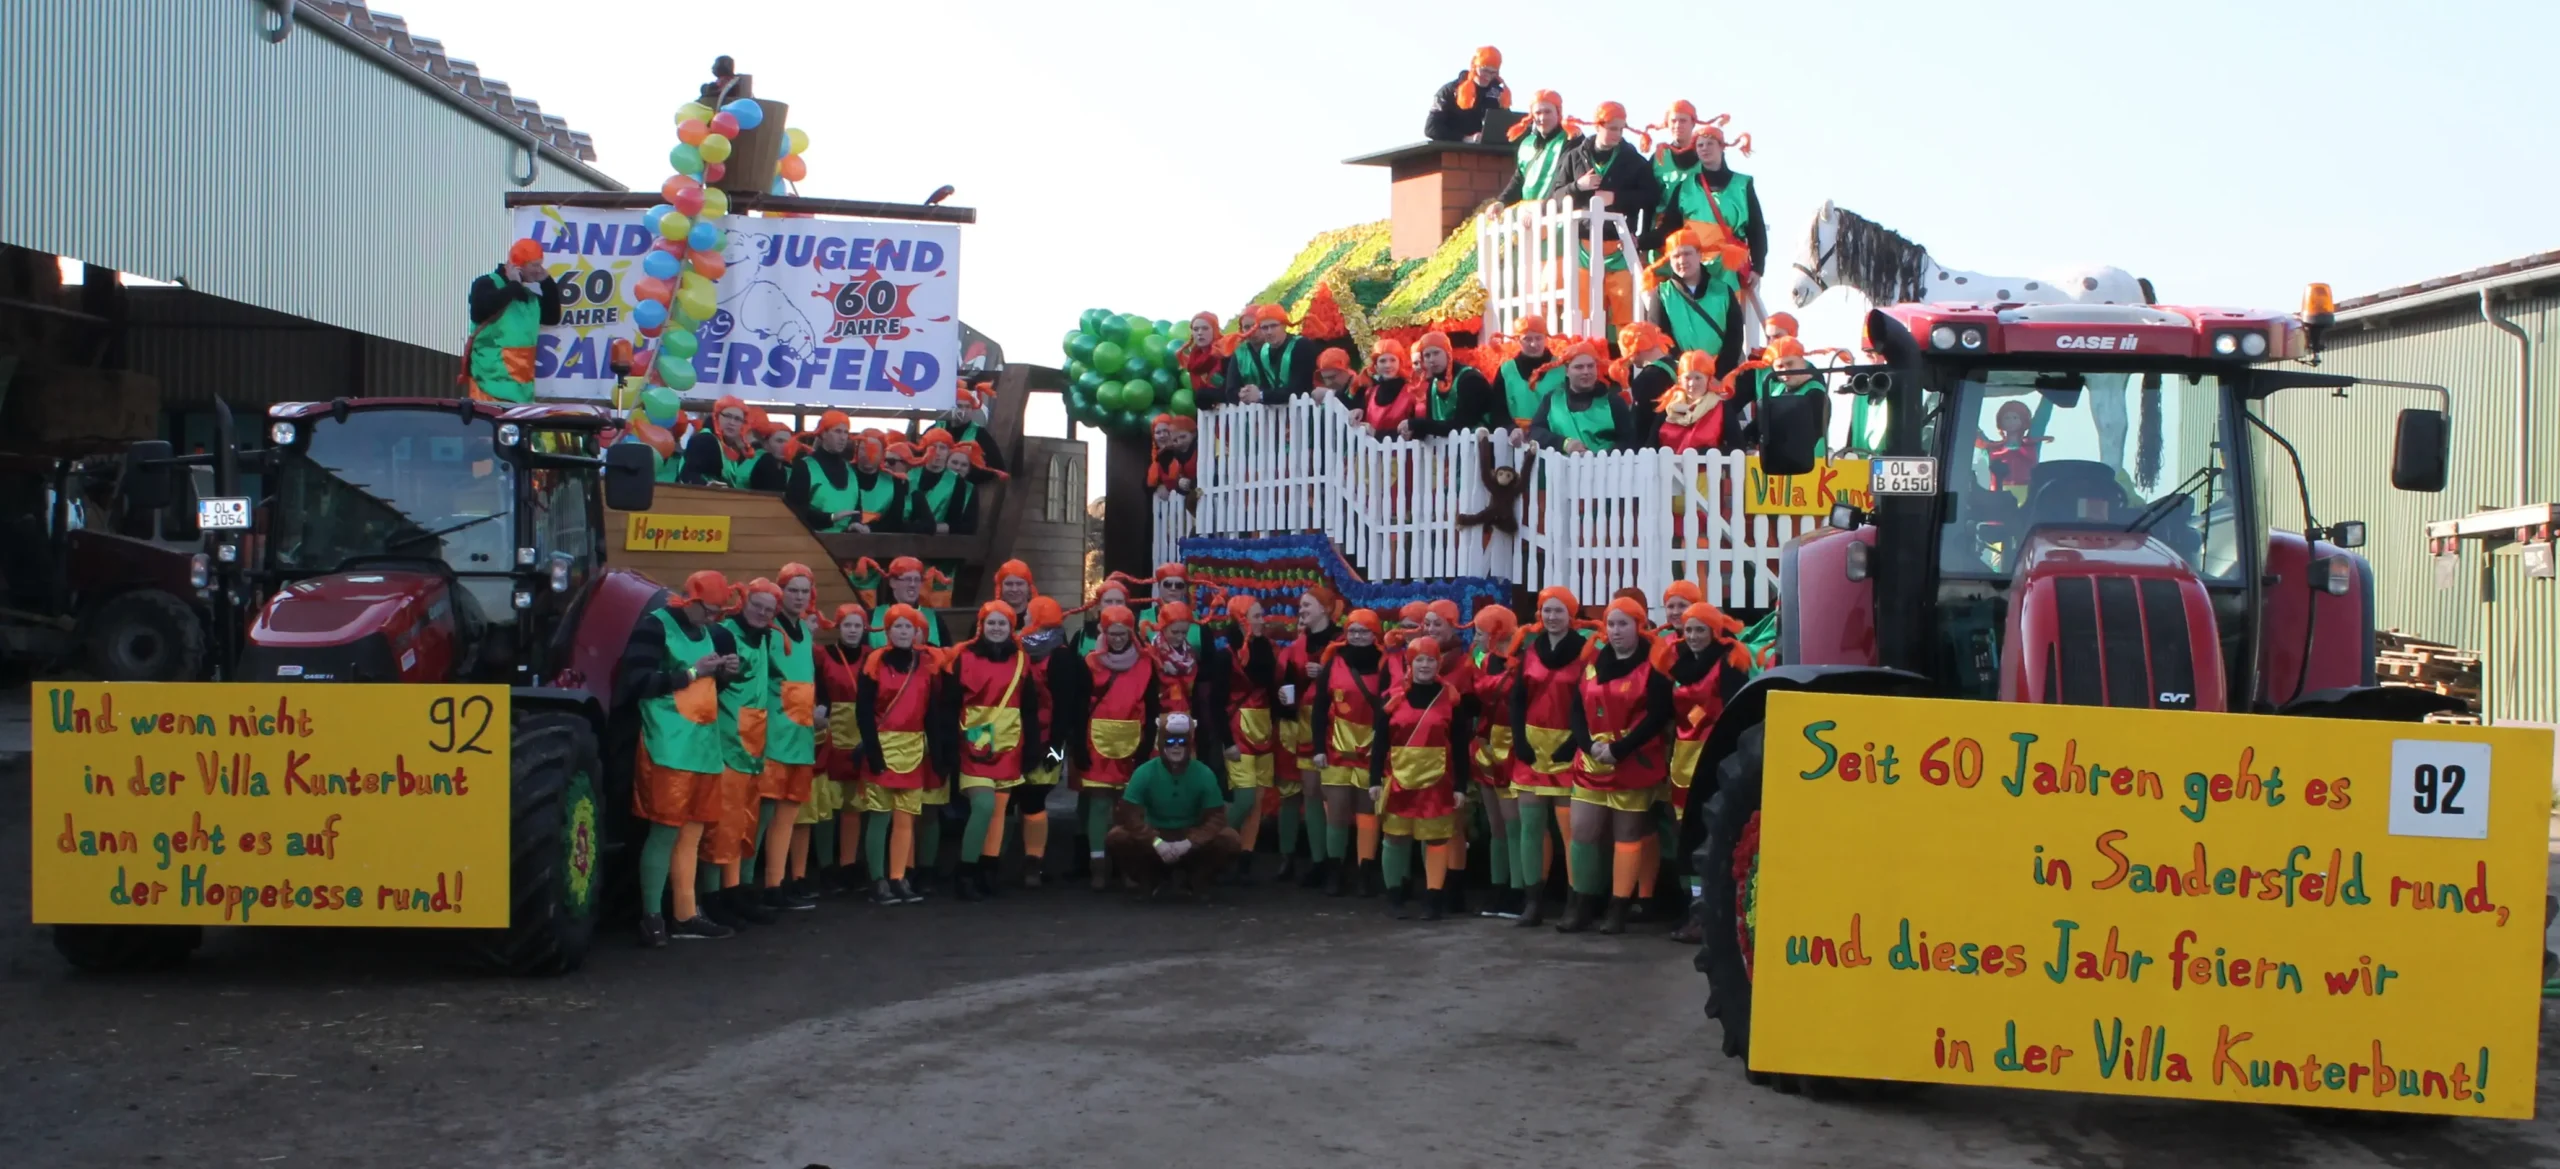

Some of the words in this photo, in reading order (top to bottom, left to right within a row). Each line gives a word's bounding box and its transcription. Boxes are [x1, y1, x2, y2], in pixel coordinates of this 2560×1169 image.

[531, 220, 652, 256] LAND
[762, 234, 944, 273] JUGEND
[558, 269, 615, 306] 60
[835, 280, 897, 317] 60
[561, 307, 618, 325] AHRE
[834, 318, 901, 336] JAHRE
[534, 334, 940, 392] SAERSFELD
[2056, 335, 2116, 350] CASE
[1751, 466, 1807, 508] Villa
[1876, 476, 1886, 491] B
[1892, 477, 1930, 492] 6150
[1891, 461, 1910, 476] OL
[203, 514, 210, 526] F
[213, 514, 243, 526] 1054
[214, 502, 230, 514] OL
[634, 516, 722, 549] Hoppetosse
[49, 688, 118, 733] Und
[130, 713, 216, 736] wenn
[229, 695, 314, 737] nicht
[2160, 692, 2190, 703] CVT
[429, 694, 493, 754] 92
[84, 765, 114, 796] in
[127, 755, 186, 796] der
[196, 750, 270, 797] Villa
[284, 749, 469, 797] Kunterbunt
[1800, 720, 1900, 785] Seit
[1919, 736, 1984, 788] 60
[2001, 731, 2164, 800] Jahren
[2180, 746, 2285, 823] geht
[2304, 777, 2351, 810] es
[2413, 763, 2466, 815] 92
[57, 812, 137, 856] dann
[153, 810, 226, 870] geht
[239, 831, 273, 856] es
[286, 813, 342, 860] auf
[110, 865, 168, 906] der
[181, 864, 363, 923] Hoppetosse
[377, 870, 463, 914] rund!
[2032, 844, 2072, 891] in
[2091, 829, 2371, 908] Sandersfeld
[2390, 860, 2510, 927] rund,
[1786, 912, 1872, 969] und
[1888, 918, 2027, 977] dieses
[2044, 919, 2154, 984] Jahr
[2168, 930, 2302, 994] feiern
[2324, 955, 2398, 996] wir
[1934, 1027, 1974, 1073] in
[1994, 1020, 2074, 1076] der
[2093, 1016, 2192, 1083] Villa
[2212, 1024, 2489, 1103] Kunterbunt!
